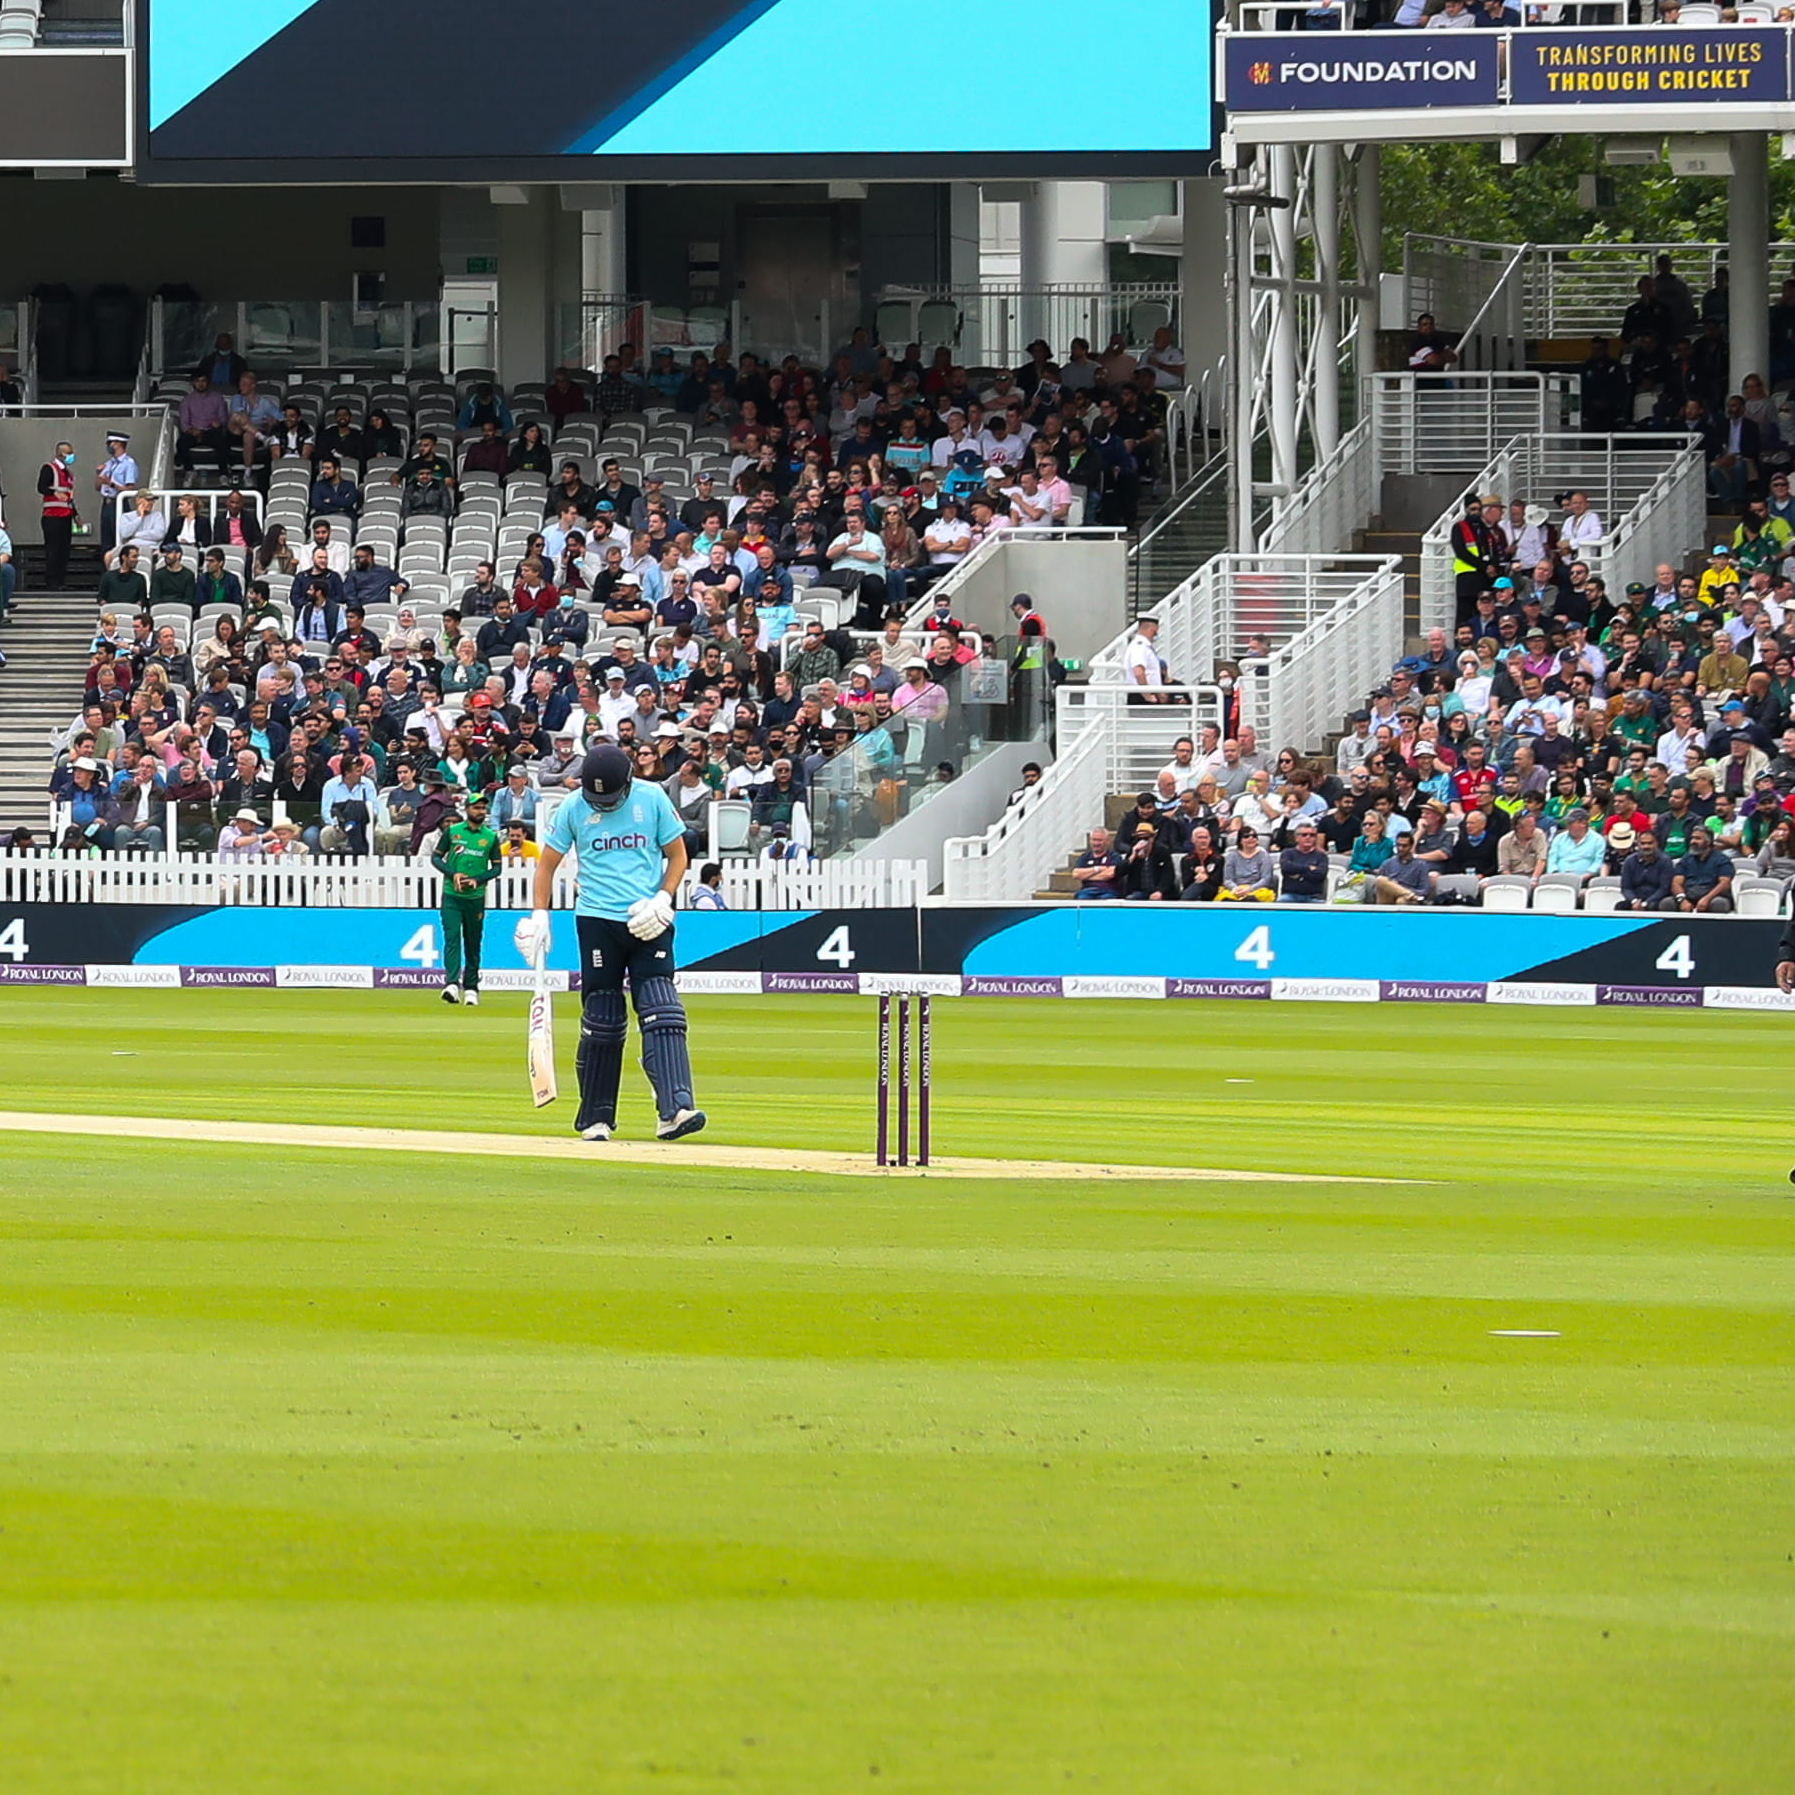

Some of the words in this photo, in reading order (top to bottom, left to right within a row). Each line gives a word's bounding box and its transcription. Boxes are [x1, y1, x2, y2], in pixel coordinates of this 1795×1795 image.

[1536, 44, 1696, 66] TRANSFORMING
[1705, 43, 1762, 63] LIVES
[1280, 60, 1477, 83] FOUNDATION
[1547, 71, 1650, 92] THROUGH
[1658, 69, 1751, 90] CRICKET
[591, 832, 647, 852] cinch
[401, 925, 438, 968] 4
[818, 926, 854, 967] 4
[1235, 926, 1274, 968] 4
[1657, 936, 1694, 978] 4
[10, 969, 40, 979] ROYAL
[42, 970, 82, 980] LONDON
[197, 973, 226, 982] ROYAL
[228, 973, 269, 982] LONDON
[390, 974, 420, 983] ROYAL
[779, 979, 809, 989] ROYAL
[811, 980, 853, 989] LONDON
[978, 983, 1009, 992] ROYAL
[1013, 983, 1056, 993] LONDON
[1175, 984, 1209, 993] ROYAL
[1213, 985, 1264, 994] LONDON
[1399, 988, 1431, 997] ROYAL
[1435, 989, 1481, 998] LONDON
[1613, 992, 1647, 1001] ROYAL
[1650, 994, 1695, 1002] LONDON
[1758, 996, 1795, 1005] LONDO
